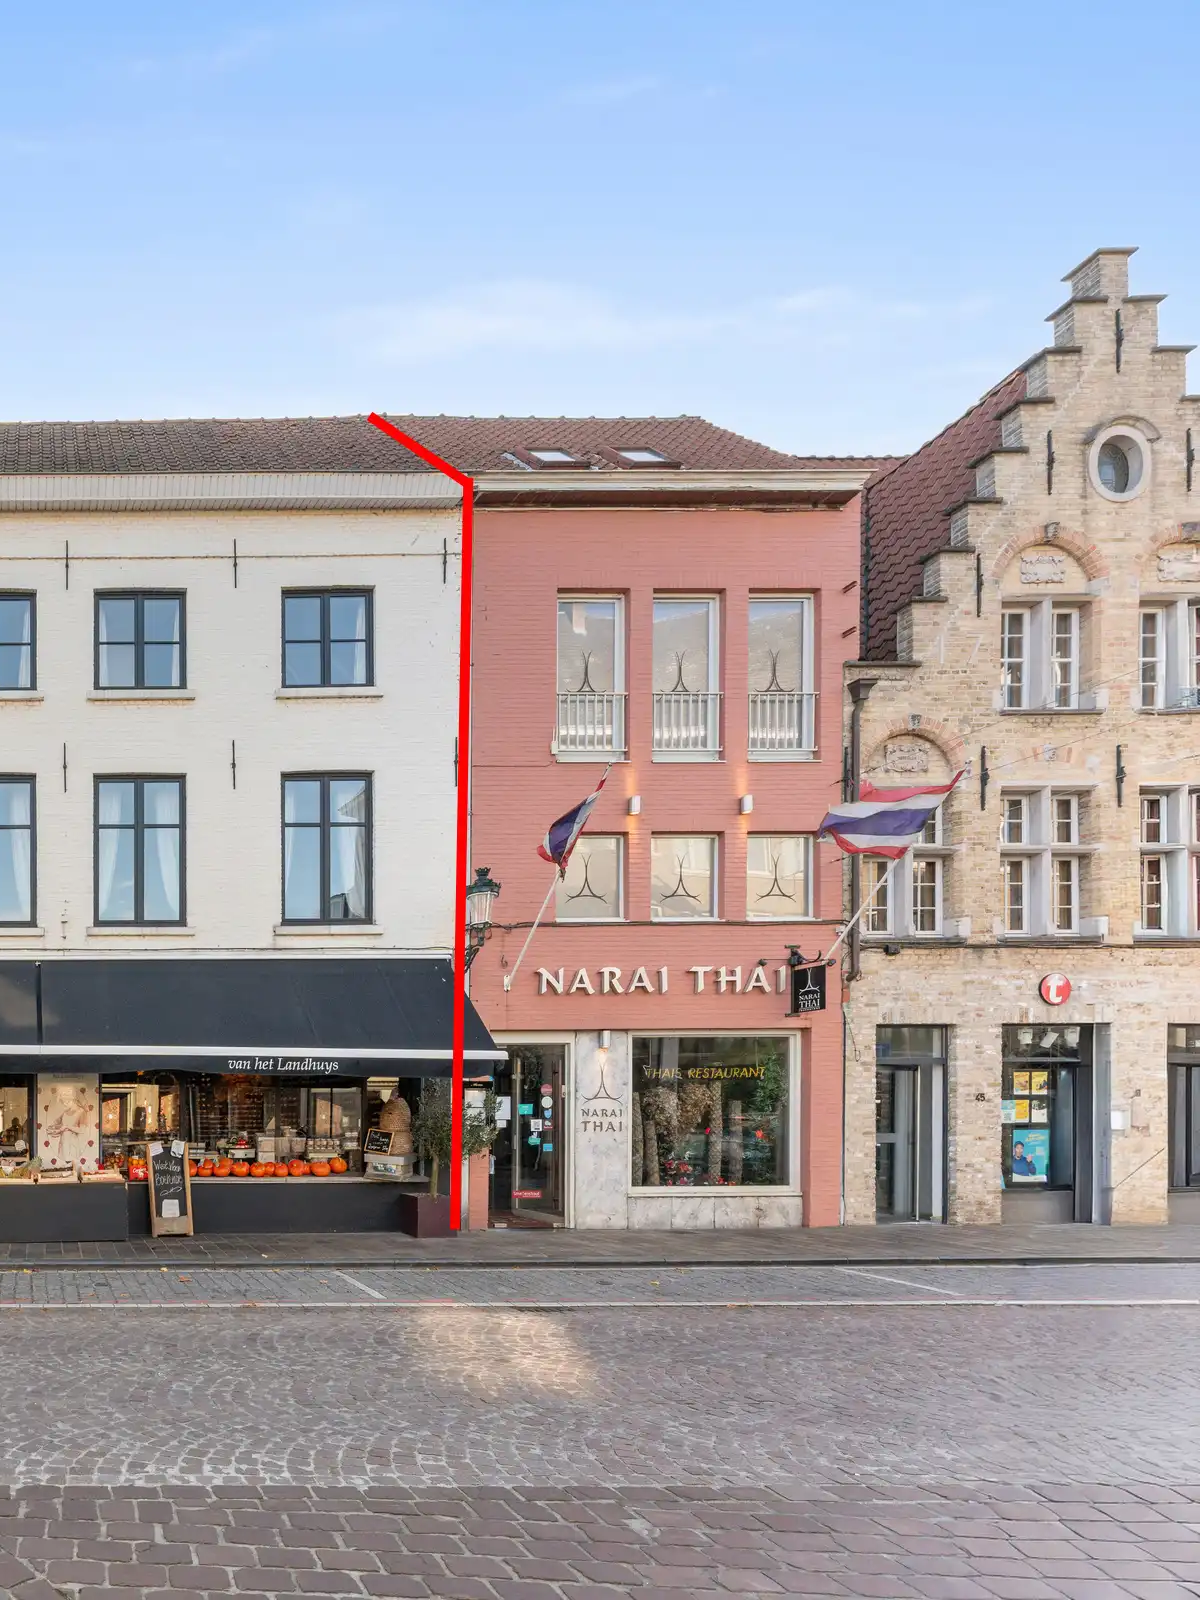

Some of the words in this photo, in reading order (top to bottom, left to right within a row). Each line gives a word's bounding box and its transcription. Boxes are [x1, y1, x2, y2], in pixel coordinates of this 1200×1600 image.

[536, 965, 669, 996] NARAI
[687, 965, 788, 996] THAI
[798, 993, 820, 1001] NARAI
[798, 999, 820, 1009] THAI
[228, 1059, 251, 1070] van
[254, 1057, 274, 1070] het
[277, 1057, 339, 1075] Landhuys
[646, 1066, 683, 1079] THAIS
[687, 1066, 766, 1079] RESTAURANT
[975, 1092, 985, 1102] 45
[580, 1108, 623, 1118] NARAI
[580, 1120, 623, 1132] THAI
